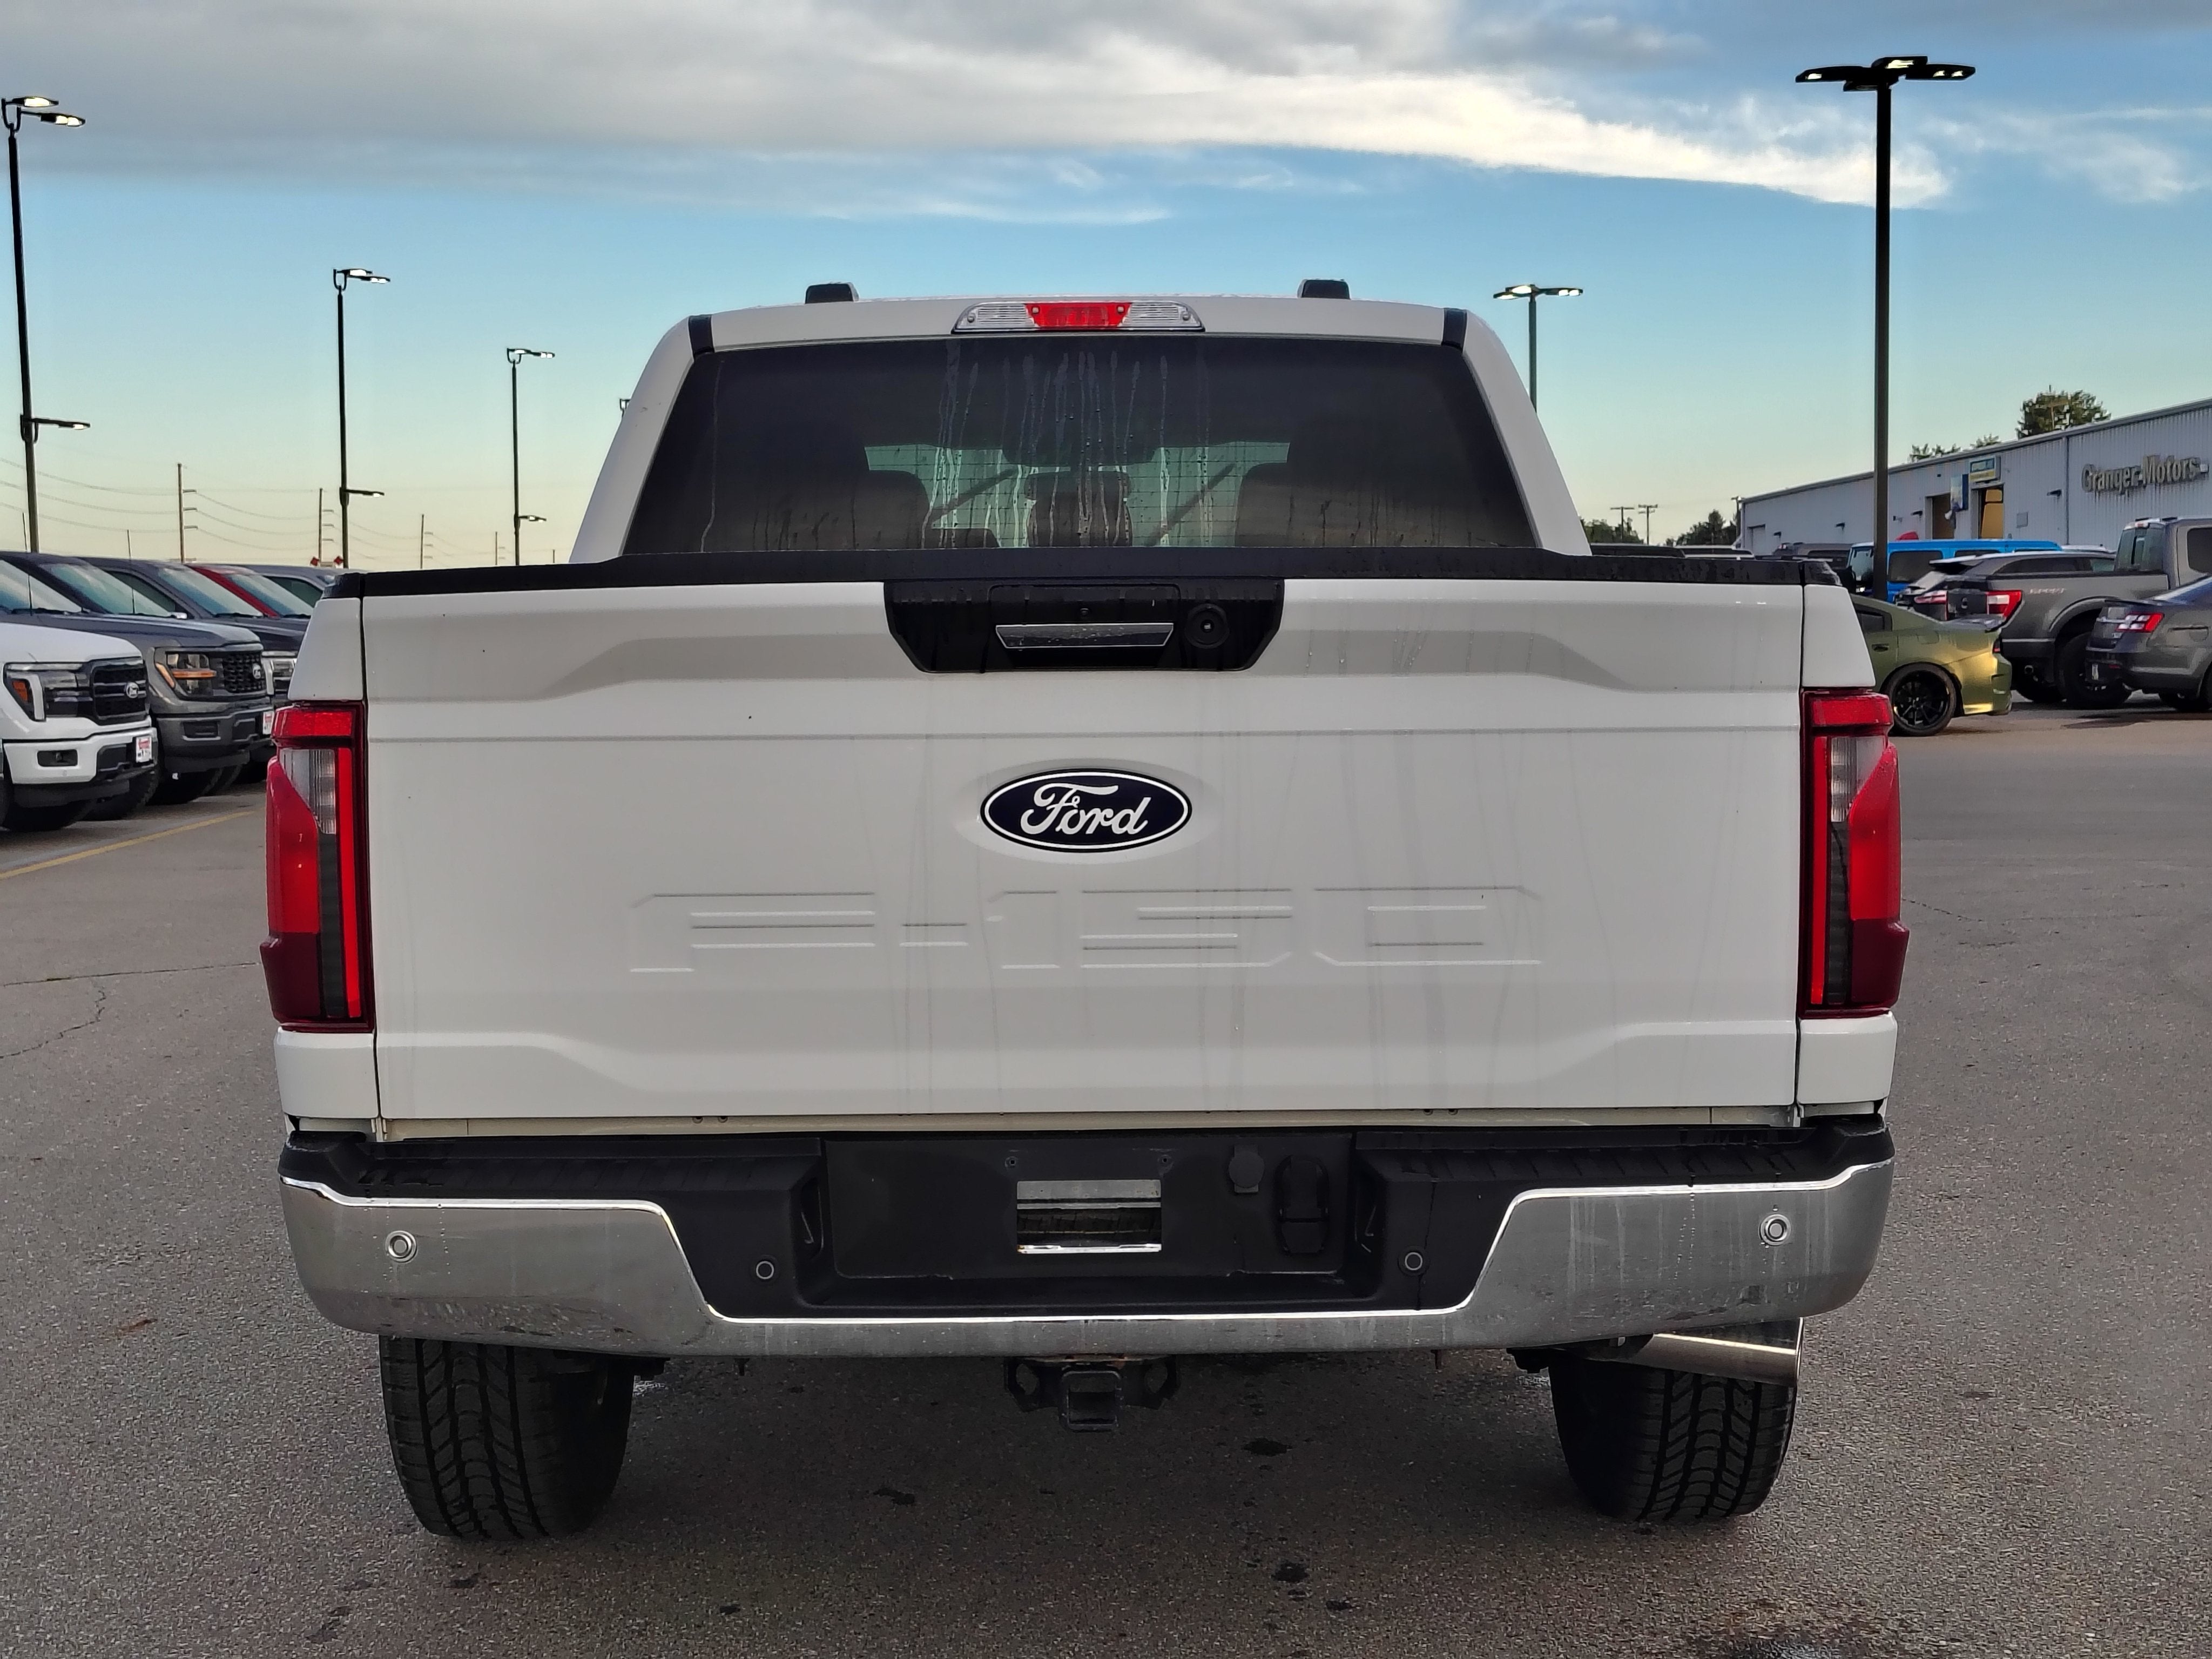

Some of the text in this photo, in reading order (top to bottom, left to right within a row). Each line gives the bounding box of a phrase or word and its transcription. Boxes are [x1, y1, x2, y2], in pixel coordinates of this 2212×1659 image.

[2081, 455, 2201, 495] Granger Motors
[1020, 782, 1151, 835] Ford
[630, 886, 1543, 973] F-150
